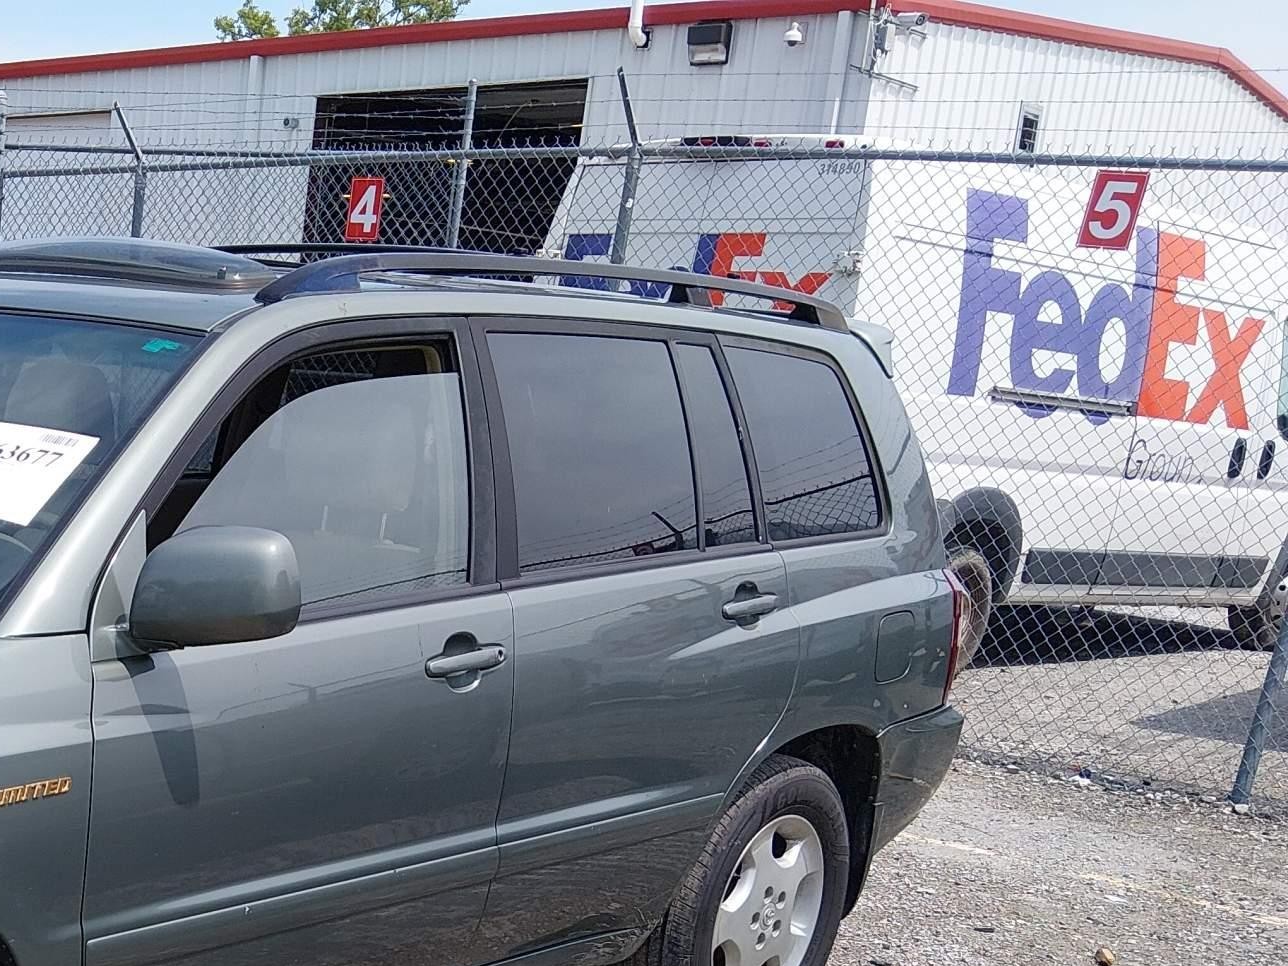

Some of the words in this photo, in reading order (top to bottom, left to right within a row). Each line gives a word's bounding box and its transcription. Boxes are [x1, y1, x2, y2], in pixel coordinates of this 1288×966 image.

[350, 185, 377, 233] 4
[1087, 181, 1139, 240] 5
[947, 187, 1266, 431] FedEx
